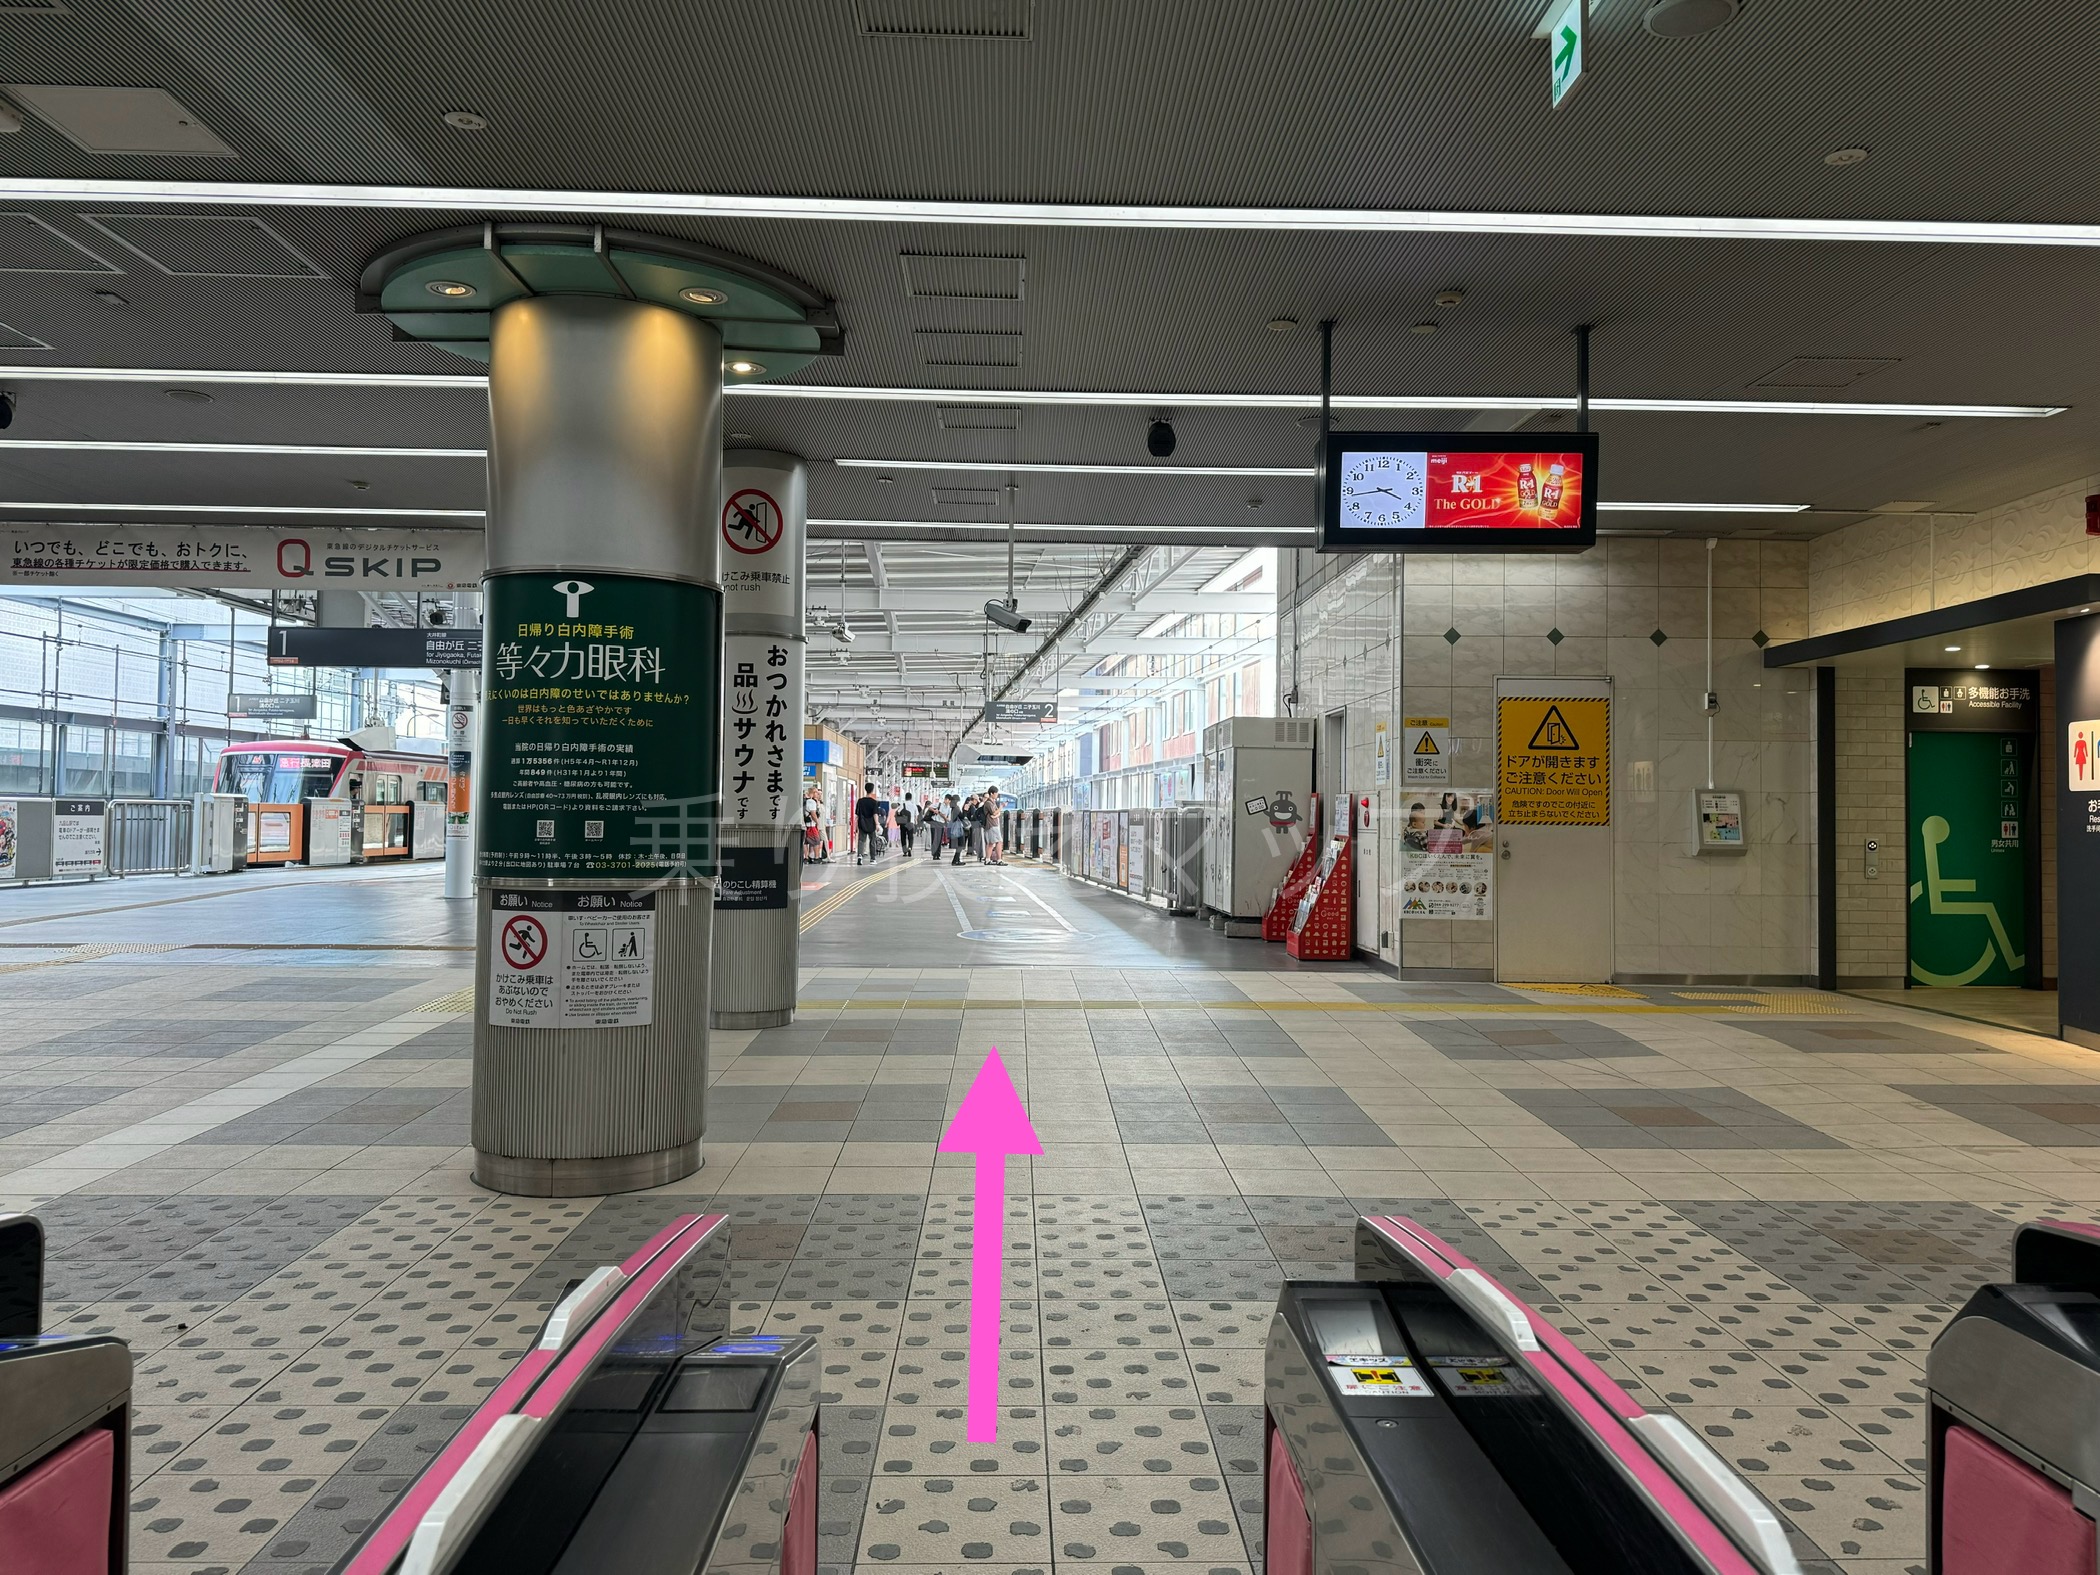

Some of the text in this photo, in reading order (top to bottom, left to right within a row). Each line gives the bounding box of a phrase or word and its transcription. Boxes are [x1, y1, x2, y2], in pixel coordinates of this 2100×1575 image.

[1378, 460, 1390, 468] 12
[1430, 457, 1448, 465] meiji
[1364, 463, 1374, 472] 11
[1396, 462, 1400, 472] 1
[1353, 472, 1364, 482] 10
[1406, 472, 1414, 480] 2
[1346, 486, 1354, 495] 9
[1412, 487, 1420, 496] 3
[1352, 502, 1360, 510] 8
[1403, 502, 1412, 510] 4
[1434, 498, 1500, 510] The GOLD
[1364, 512, 1372, 520] 7
[1378, 514, 1386, 522] 6
[1392, 512, 1400, 520] 5
[14, 540, 248, 559] いつでも、どこでも、おトクに、
[326, 542, 440, 551] 東急線のデジタルチケットサービス
[12, 557, 249, 572] 東急線の各種チケットが限定価格で購入できます。
[324, 557, 442, 578] SKIP
[740, 583, 760, 591] rush
[518, 623, 635, 640] 日帰り白内障手術
[278, 630, 287, 656] 1
[426, 640, 464, 651] 自由が丘
[496, 642, 666, 684] 等々力眼科
[1968, 686, 2030, 700] 多機能お手洗
[235, 696, 240, 712] 1
[517, 704, 632, 715] 世界はもっと色あざやかです
[1044, 704, 1054, 718] 2
[502, 716, 654, 728] 一日も早くそれを知っていただくために
[764, 645, 790, 821] おつかれさまです
[514, 742, 634, 754] 当院の日帰り白内障手術の実績
[280, 758, 332, 768] 急行 長津田
[1415, 758, 1438, 767] 衝突に
[1506, 755, 1600, 769] ドアが開きます
[1506, 772, 1602, 785] ご注意ください
[1504, 788, 1603, 798] CAUTION: Door Will Open
[1512, 800, 1596, 809] 危険ですのでこの付近に
[2088, 799, 2100, 813] お
[1508, 810, 1600, 819] 立ち止まらないでください
[722, 880, 777, 889] のりこし精算機
[500, 894, 528, 907] お願い
[577, 895, 616, 908] お願い
[496, 974, 554, 985] かけこみ乗車は
[498, 986, 548, 996] あぶないので
[495, 998, 553, 1008] おやめください
